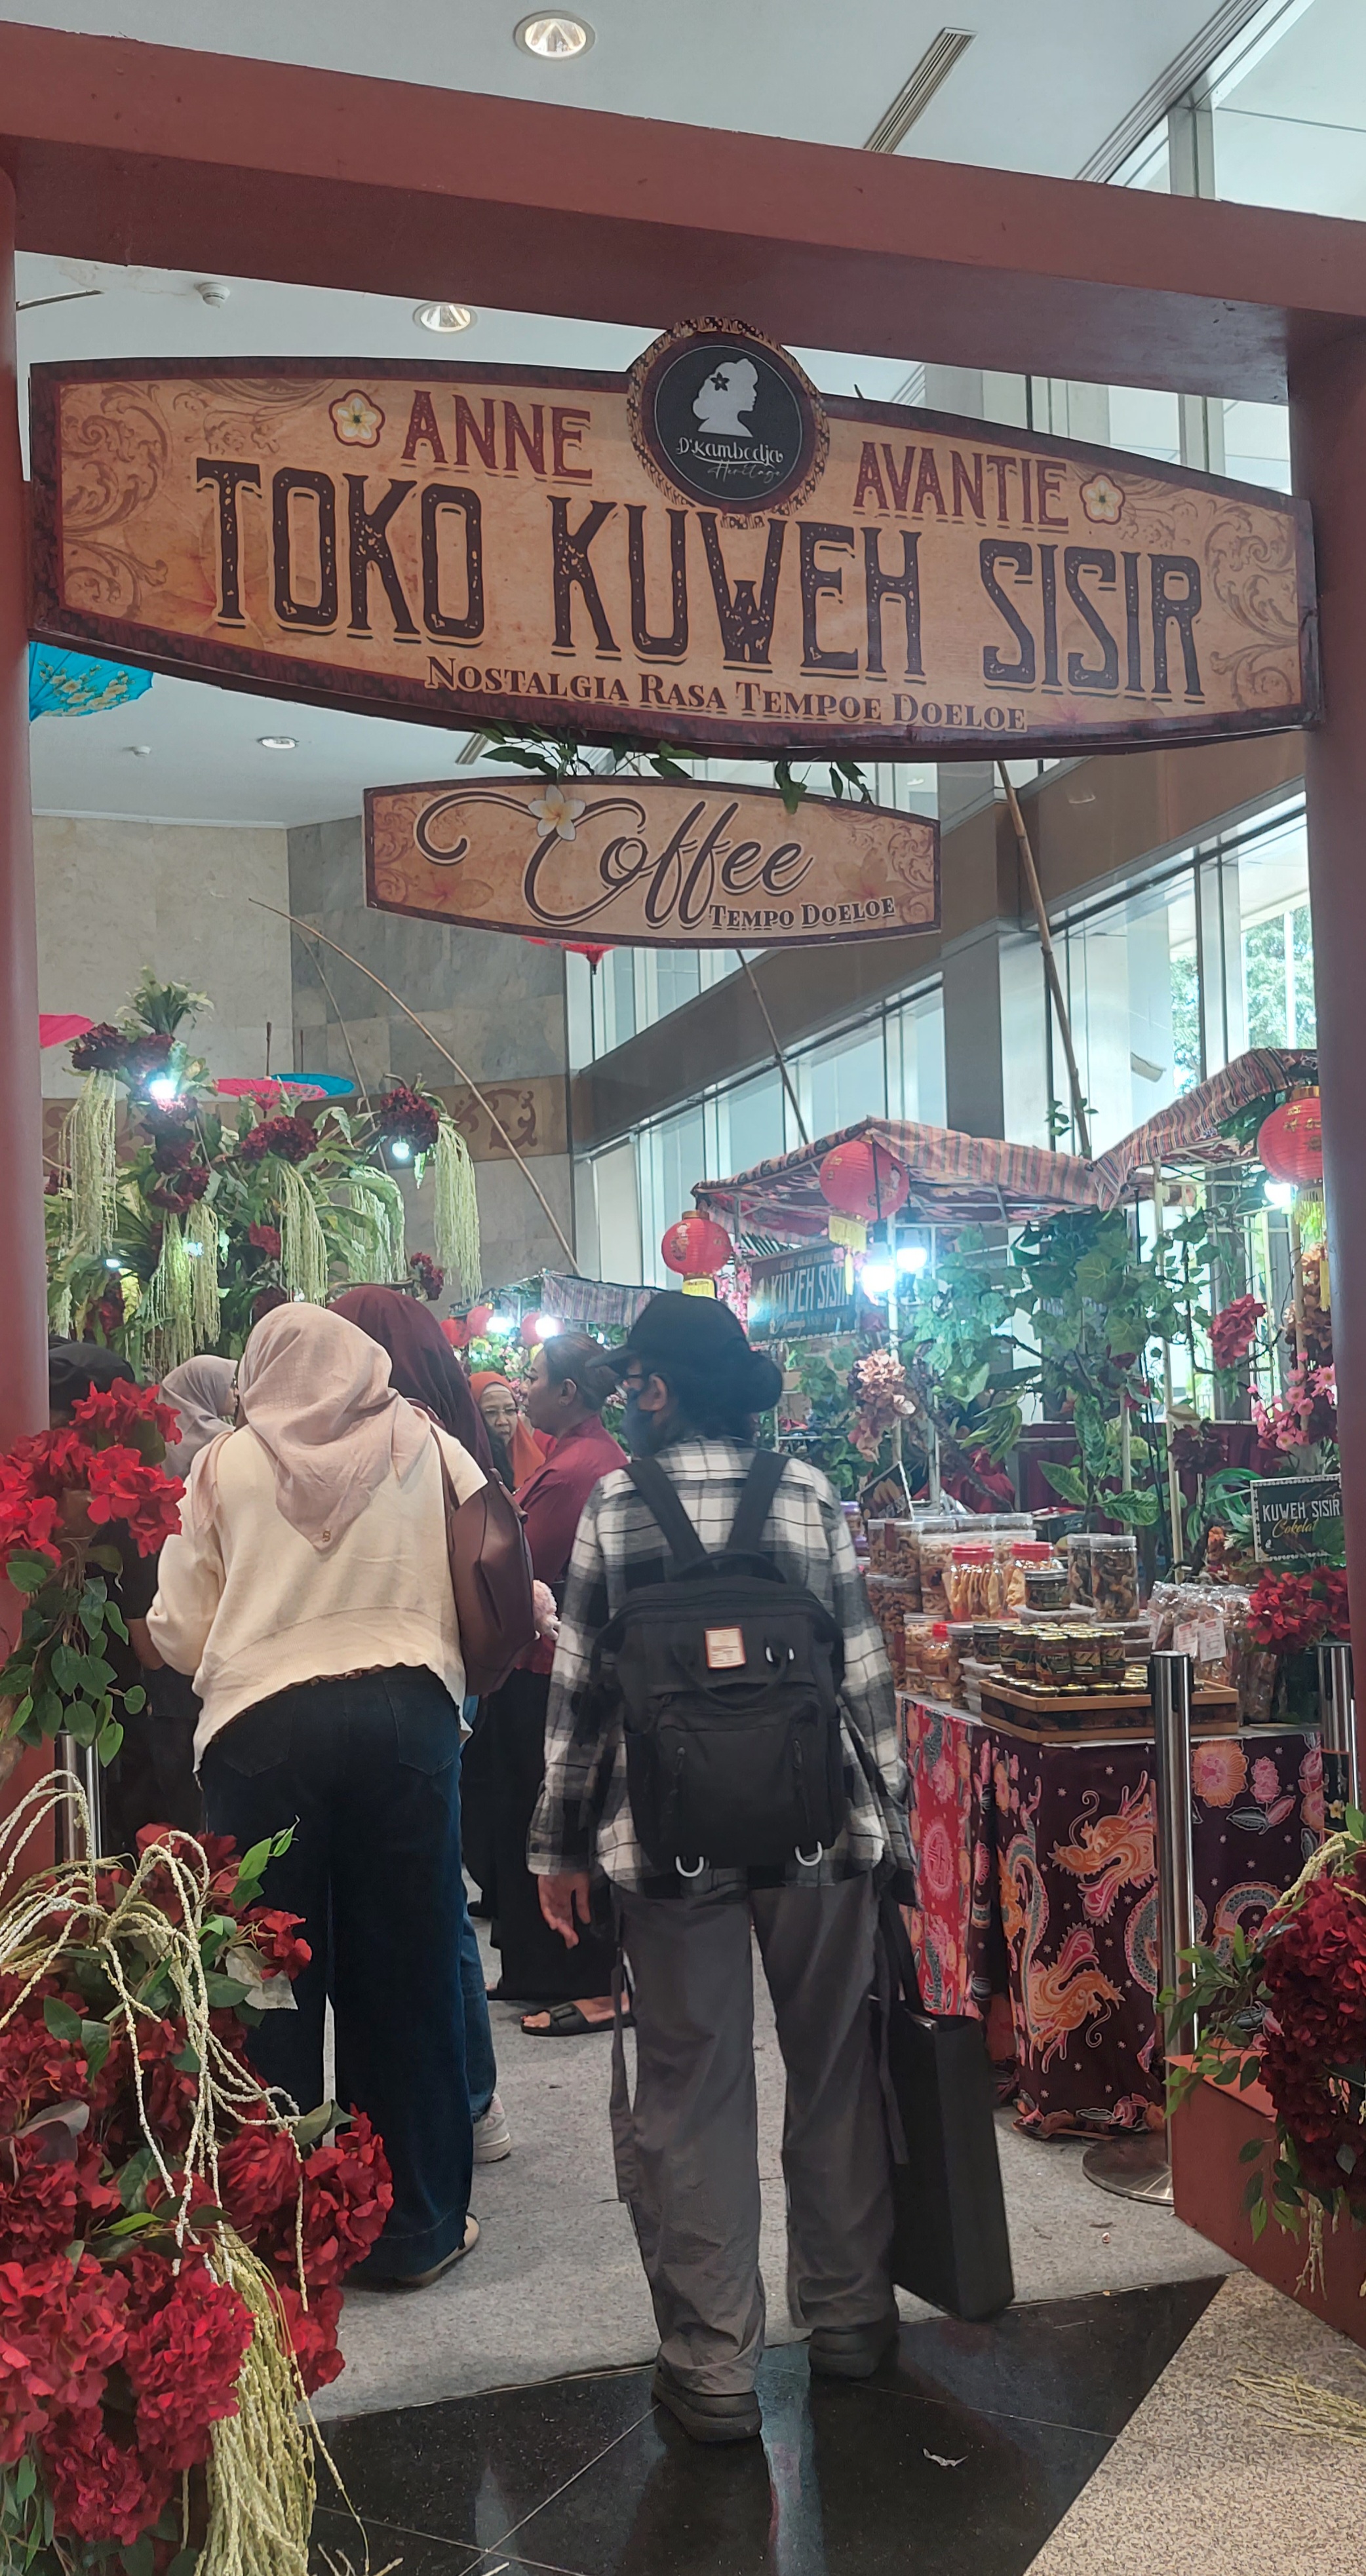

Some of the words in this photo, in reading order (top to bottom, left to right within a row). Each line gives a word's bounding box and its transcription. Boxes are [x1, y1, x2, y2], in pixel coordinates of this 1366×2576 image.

[402, 390, 593, 482] ANNE
[853, 440, 1069, 528] AVANTIE
[707, 460, 782, 482] Heritage
[195, 457, 484, 642] TOKO
[546, 495, 926, 679] KUWEH
[979, 539, 1203, 699] SISIR
[426, 655, 630, 703] NOSTALGIA
[638, 673, 728, 711] RASA
[735, 682, 882, 721] TEMPOE
[892, 693, 1026, 730] DOELOE
[416, 791, 813, 928] Coffee
[709, 904, 794, 929] TEMPO
[801, 897, 895, 927] DOELOE
[771, 1267, 815, 1313] KUWEH
[1262, 1502, 1306, 1523] KUWEH
[1312, 1499, 1340, 1518] SISIR
[1272, 1518, 1319, 1539] Cokelat
